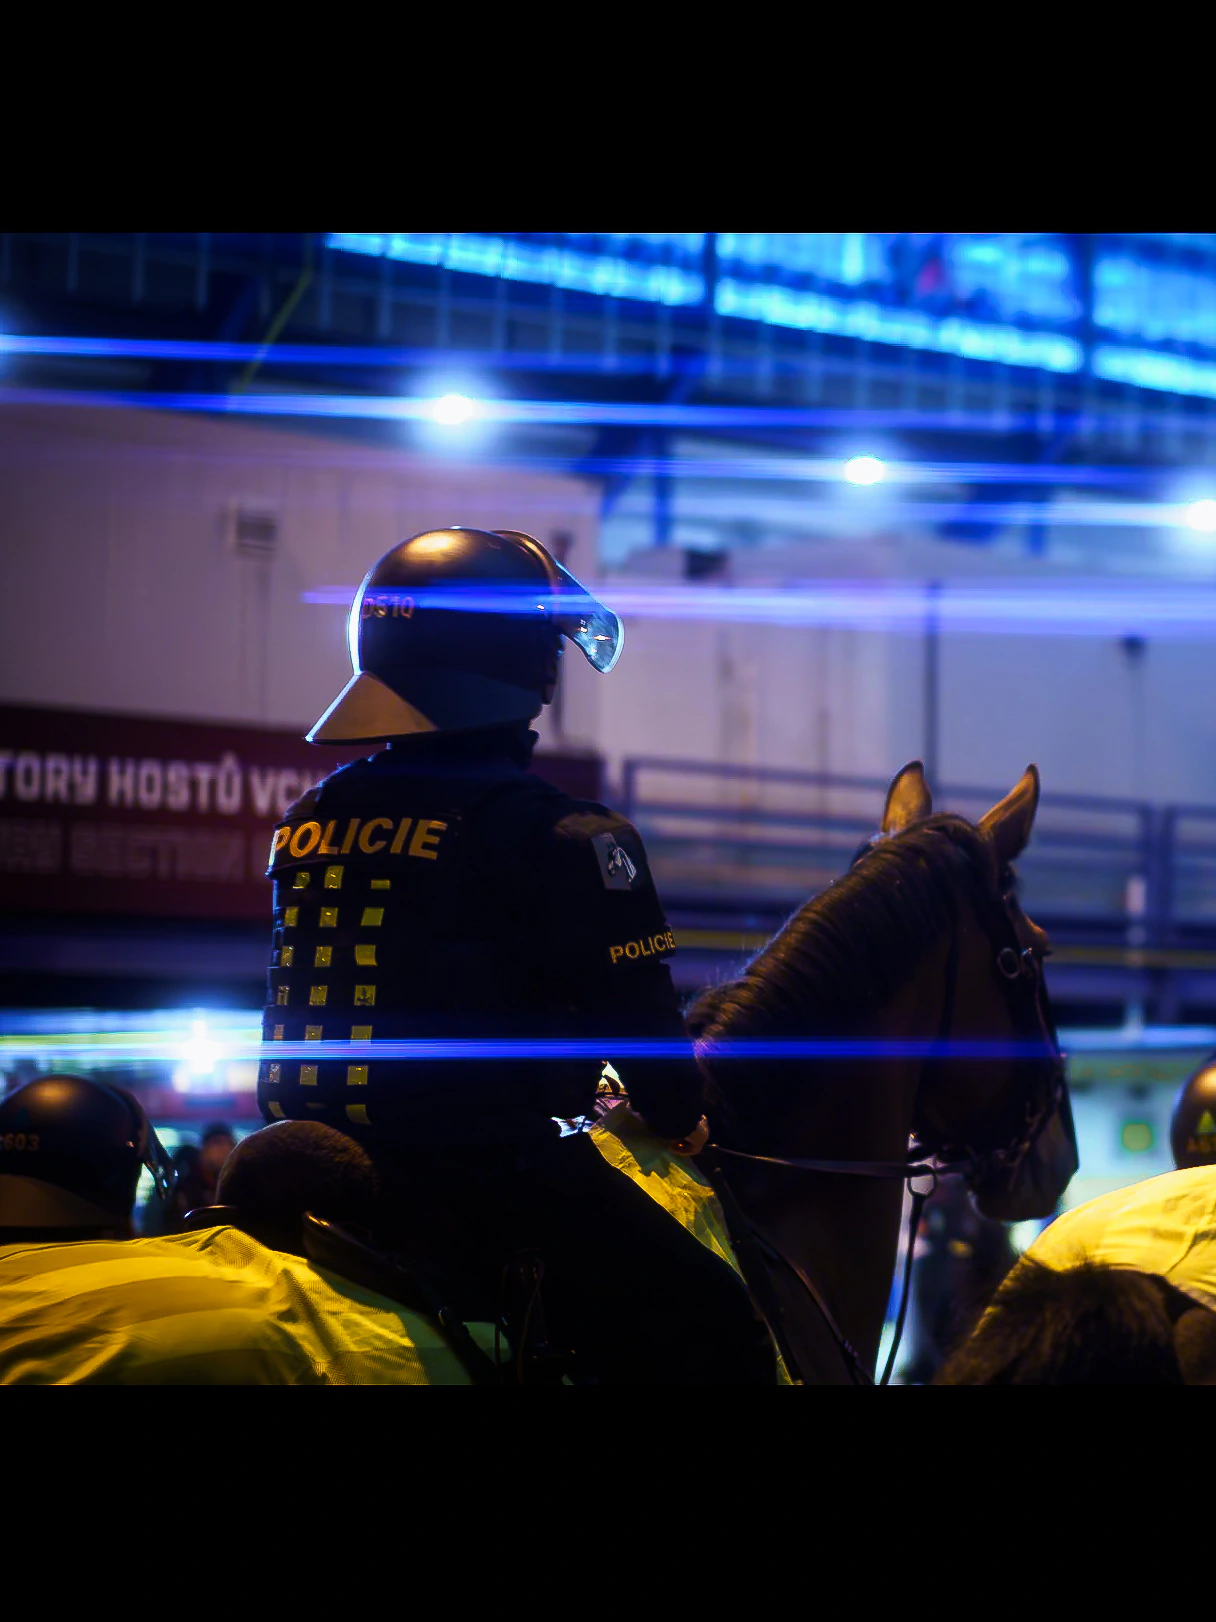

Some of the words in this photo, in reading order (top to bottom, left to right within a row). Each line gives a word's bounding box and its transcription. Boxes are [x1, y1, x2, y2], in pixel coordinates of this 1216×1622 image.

[107, 752, 243, 816] HOSTŮ
[249, 765, 322, 820] VC
[272, 817, 448, 860] POLICIE
